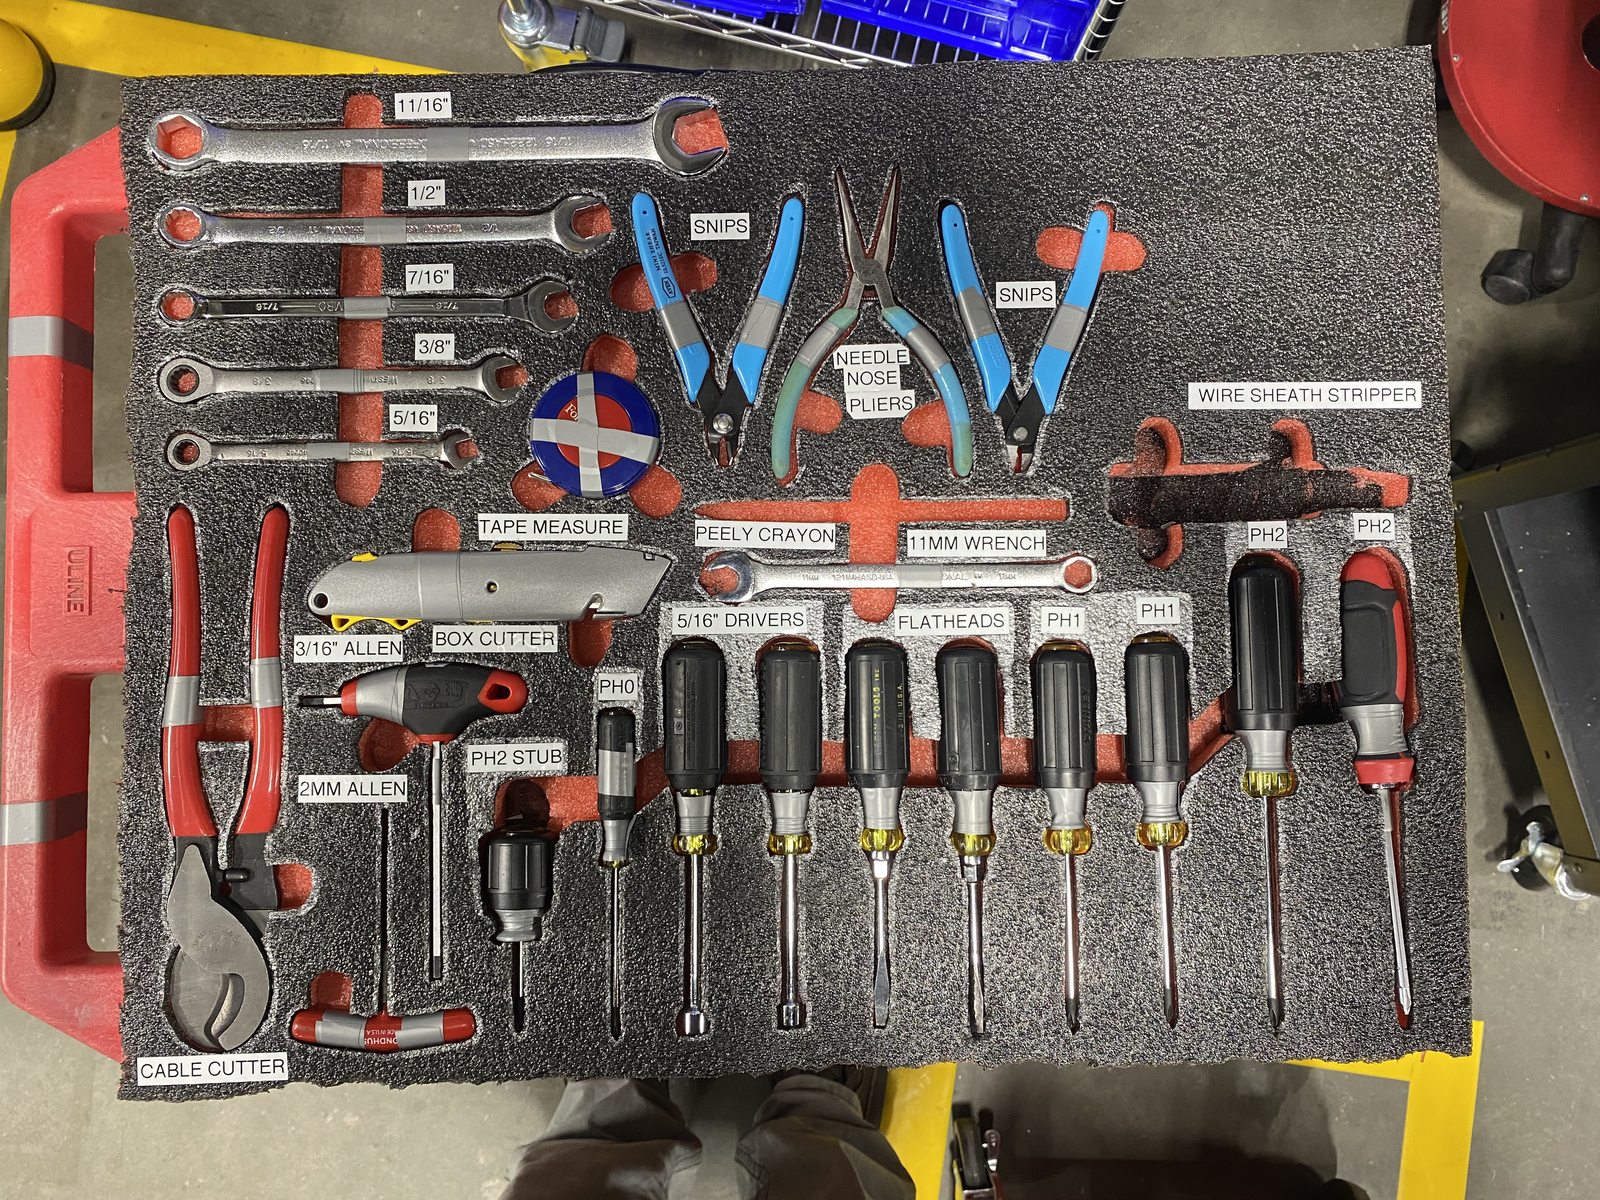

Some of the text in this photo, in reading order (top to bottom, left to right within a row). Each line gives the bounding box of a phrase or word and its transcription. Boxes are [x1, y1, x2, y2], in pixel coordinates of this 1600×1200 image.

[398, 97, 448, 113] 11/16"
[411, 185, 441, 201] 1/2"
[694, 218, 748, 235] SNIPS
[650, 227, 661, 250] TAIWAN
[645, 231, 662, 272] MINI SHEAR
[408, 269, 449, 285] 7/16"
[663, 280, 674, 295] AVEN
[999, 286, 1053, 303] SNIPS
[255, 302, 279, 311] 7/16
[418, 339, 451, 355] 3/8"
[836, 349, 907, 366] NEEDLE
[847, 370, 897, 386] NOSE
[1198, 387, 1416, 403] WIRE SHEATH STRIPPER
[850, 395, 913, 413] PLIERS
[393, 410, 435, 426] 5/16"
[479, 519, 623, 535] TAPE MEASURE
[1358, 518, 1392, 533] PH2
[696, 526, 834, 543] PEELY CRAYON
[1250, 527, 1285, 542] PH2
[910, 536, 1045, 551] 11MM WRENCH
[67, 549, 85, 613] ULINE
[1141, 603, 1173, 618] PH1
[677, 612, 804, 629] 5/16" DRIVERS
[898, 613, 1005, 630] FLATHEADS
[1048, 612, 1079, 627] PH1
[435, 631, 555, 647] BOX CUTTER
[295, 640, 402, 657] 3/16" ALLEN
[599, 679, 635, 695] PH0
[896, 683, 904, 707] U.S.A.
[872, 685, 881, 720] TOOLS
[471, 749, 563, 766] PH2 STUB
[299, 781, 406, 796] 2MM ALLEN
[363, 1037, 398, 1045] ONDHU
[140, 1058, 285, 1079] CABLE CUTTER
